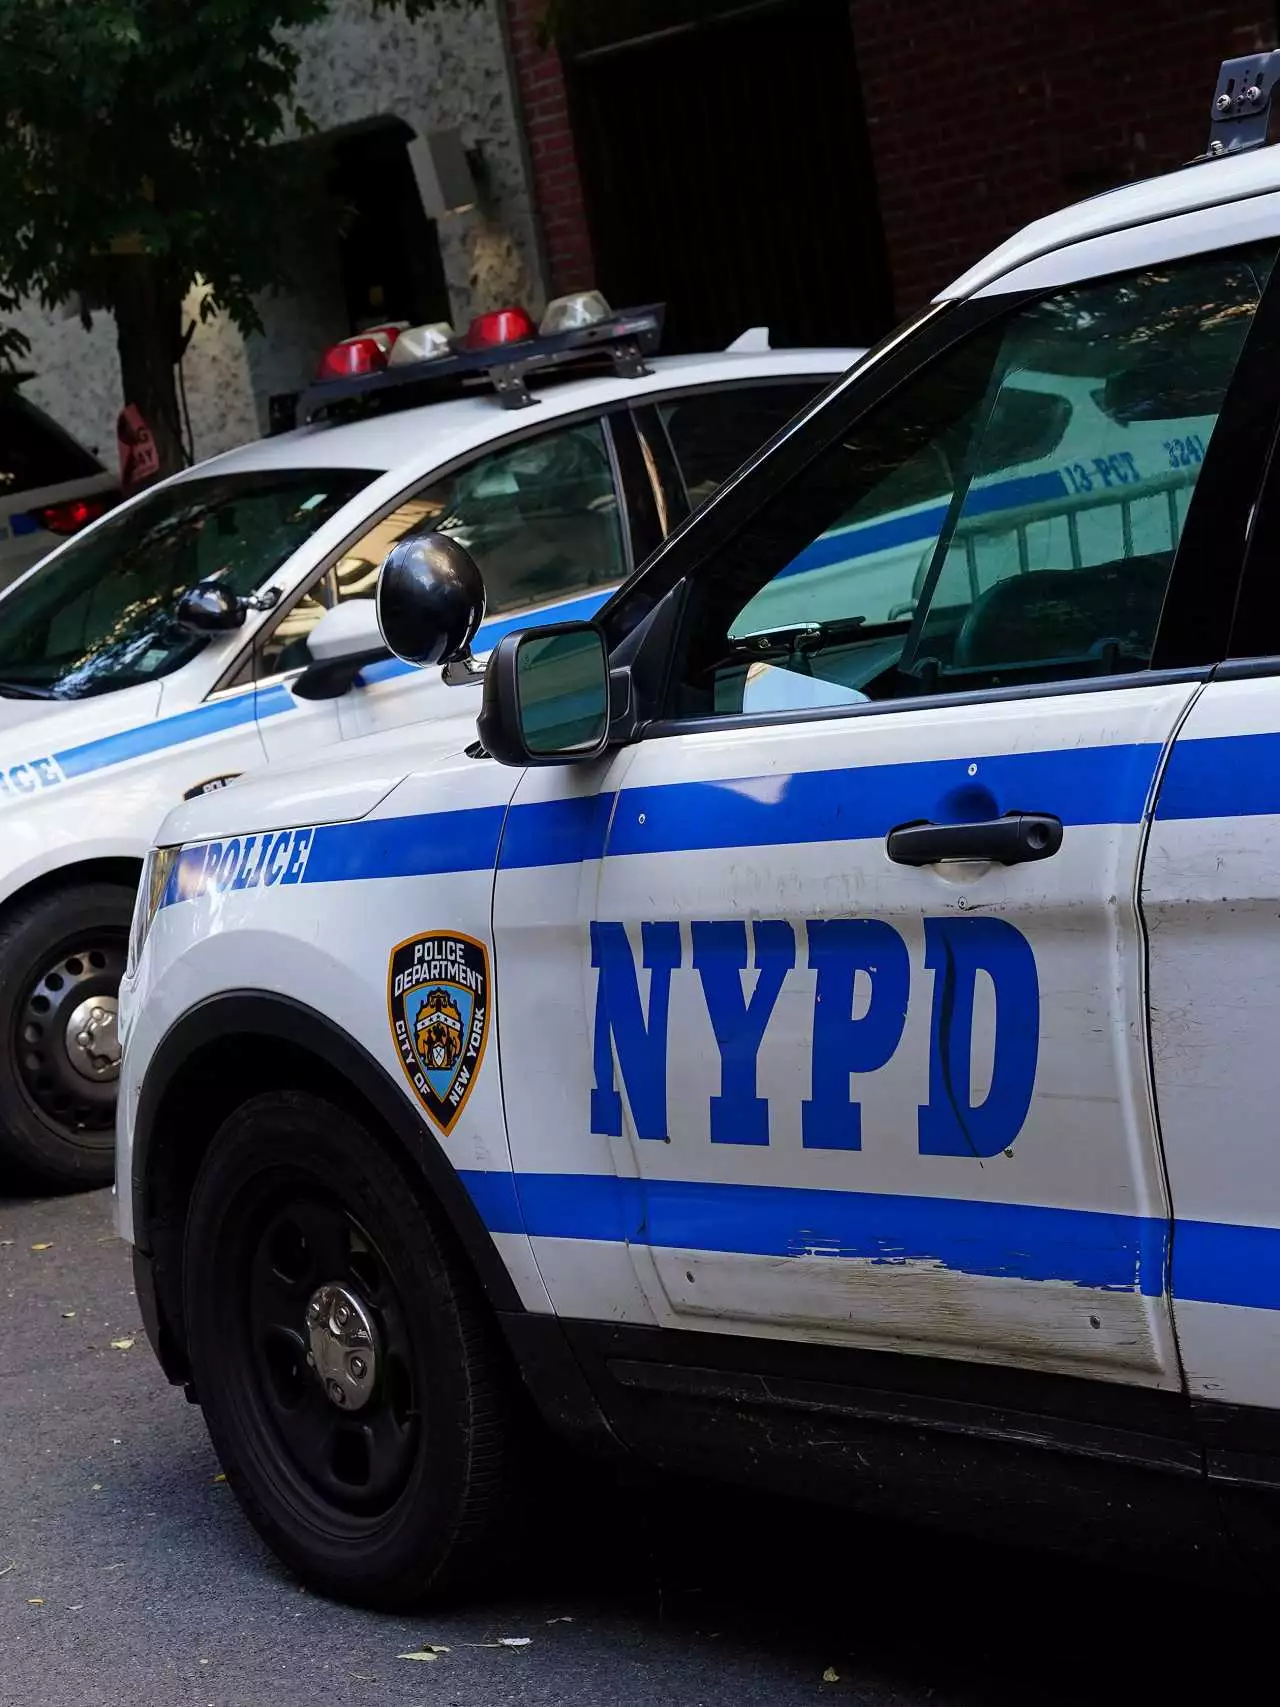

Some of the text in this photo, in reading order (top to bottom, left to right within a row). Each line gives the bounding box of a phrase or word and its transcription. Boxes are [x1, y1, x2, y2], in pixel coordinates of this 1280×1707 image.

[1091, 451, 1140, 487] PCT
[198, 829, 314, 898] POLICE
[394, 960, 484, 997] DEPARTMENT
[413, 940, 465, 964] POLICE
[395, 1007, 485, 1106] CITY OF NEW YORK
[589, 916, 1040, 1159] NYPD
